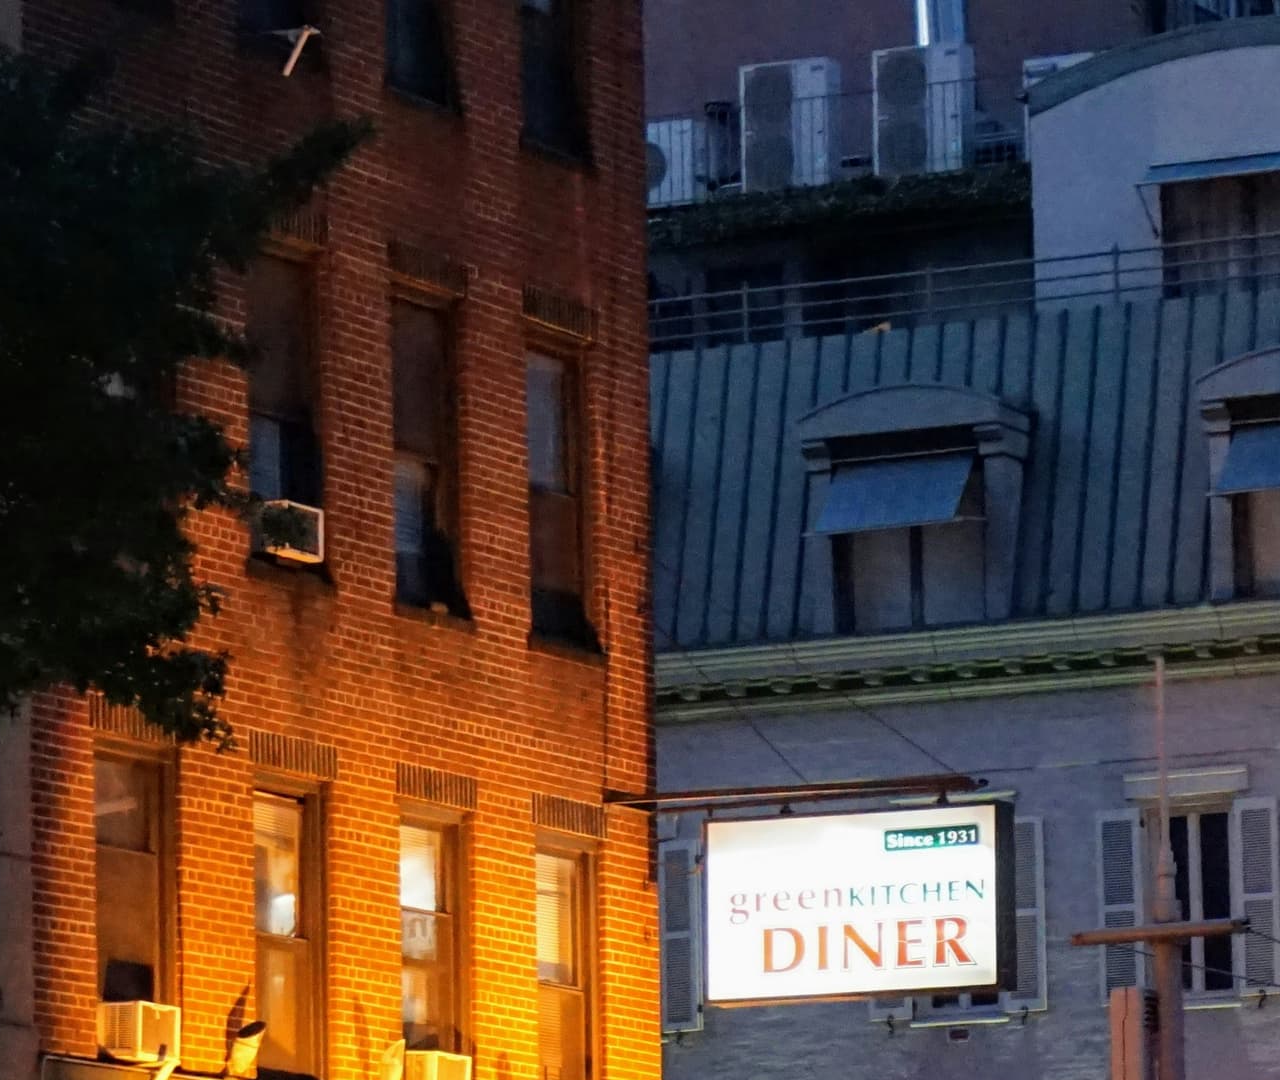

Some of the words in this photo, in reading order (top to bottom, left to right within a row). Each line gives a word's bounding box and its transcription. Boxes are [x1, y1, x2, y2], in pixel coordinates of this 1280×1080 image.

[886, 831, 934, 849] Since
[937, 828, 977, 845] 1931
[730, 878, 985, 926] greenKITCHEN
[762, 915, 977, 974] DINER
